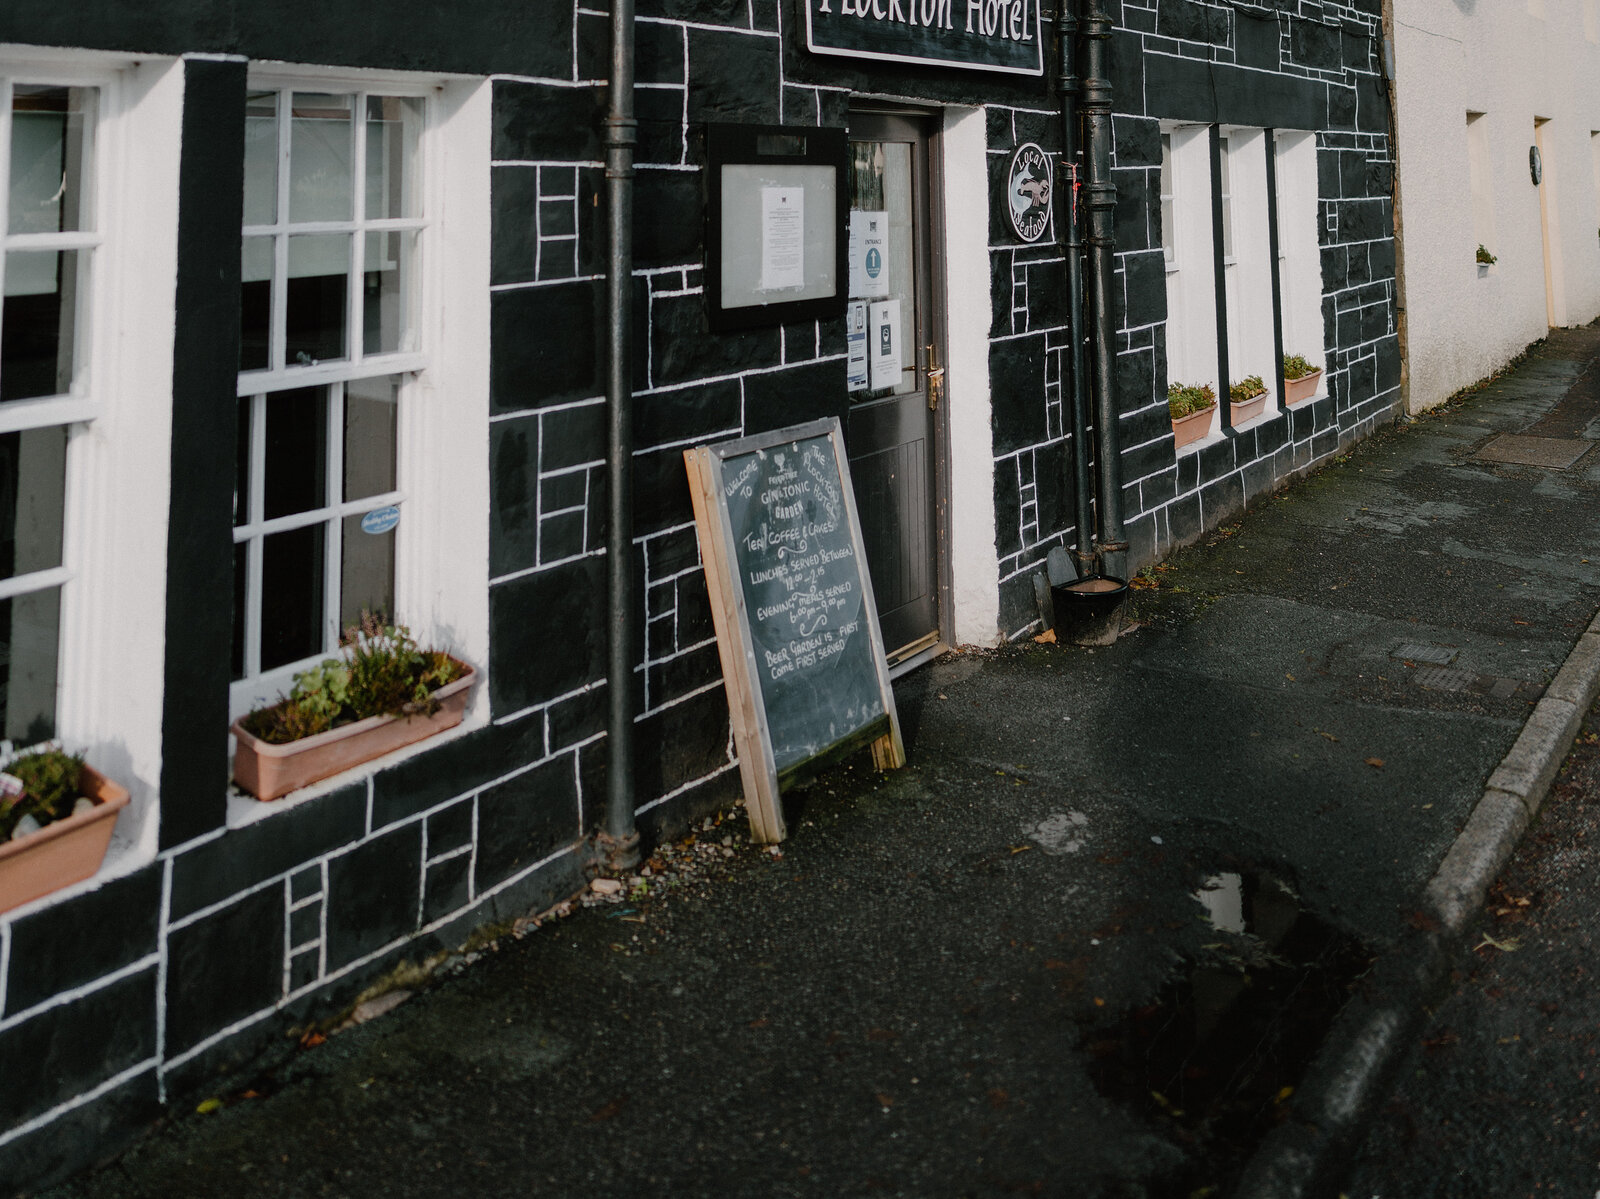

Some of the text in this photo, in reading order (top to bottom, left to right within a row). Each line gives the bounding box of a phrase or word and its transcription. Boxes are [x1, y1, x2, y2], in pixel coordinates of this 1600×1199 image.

[1017, 150, 1044, 171] Local
[1013, 211, 1047, 239] Seafood
[812, 445, 826, 466] THE
[725, 459, 758, 497] WELCOME
[740, 486, 753, 499] TO
[761, 489, 779, 504] GIN
[782, 480, 811, 498] TONIC
[803, 452, 839, 503] PLOCKTON
[775, 500, 804, 519] GARDEN
[813, 484, 836, 520] HOTEL
[768, 527, 800, 545] COFFEE
[808, 522, 835, 536] CAKES
[750, 545, 853, 585] LUNCHES SERVED BETWEEN
[757, 582, 852, 621] EVENING MEALS SERVED
[765, 622, 859, 668] BEER GARDEN IS FIRST
[771, 640, 845, 680] COME FIRST SERVED
